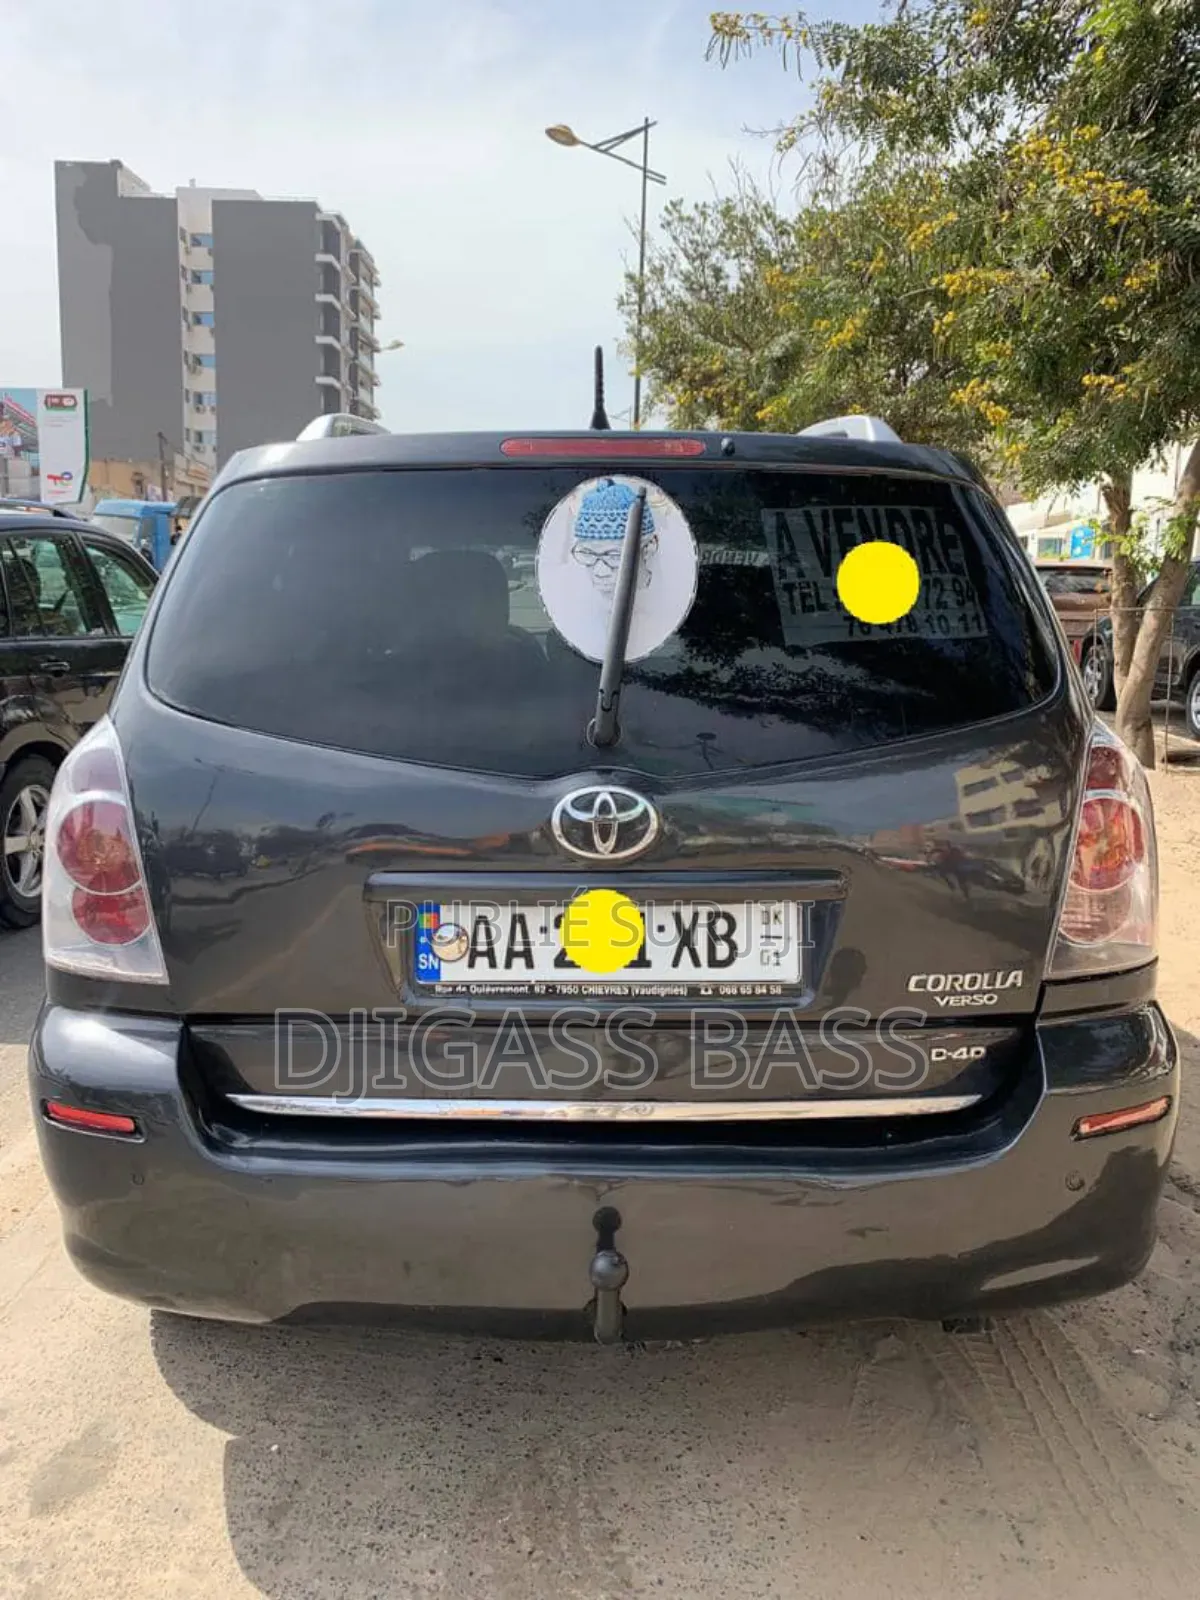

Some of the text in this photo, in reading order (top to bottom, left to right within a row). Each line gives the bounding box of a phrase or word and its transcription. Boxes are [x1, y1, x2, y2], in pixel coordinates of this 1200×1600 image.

[418, 953, 439, 970] SN
[908, 970, 1024, 992] COROLLA
[934, 993, 998, 1008] VERSO
[931, 1046, 987, 1061] D-4D
